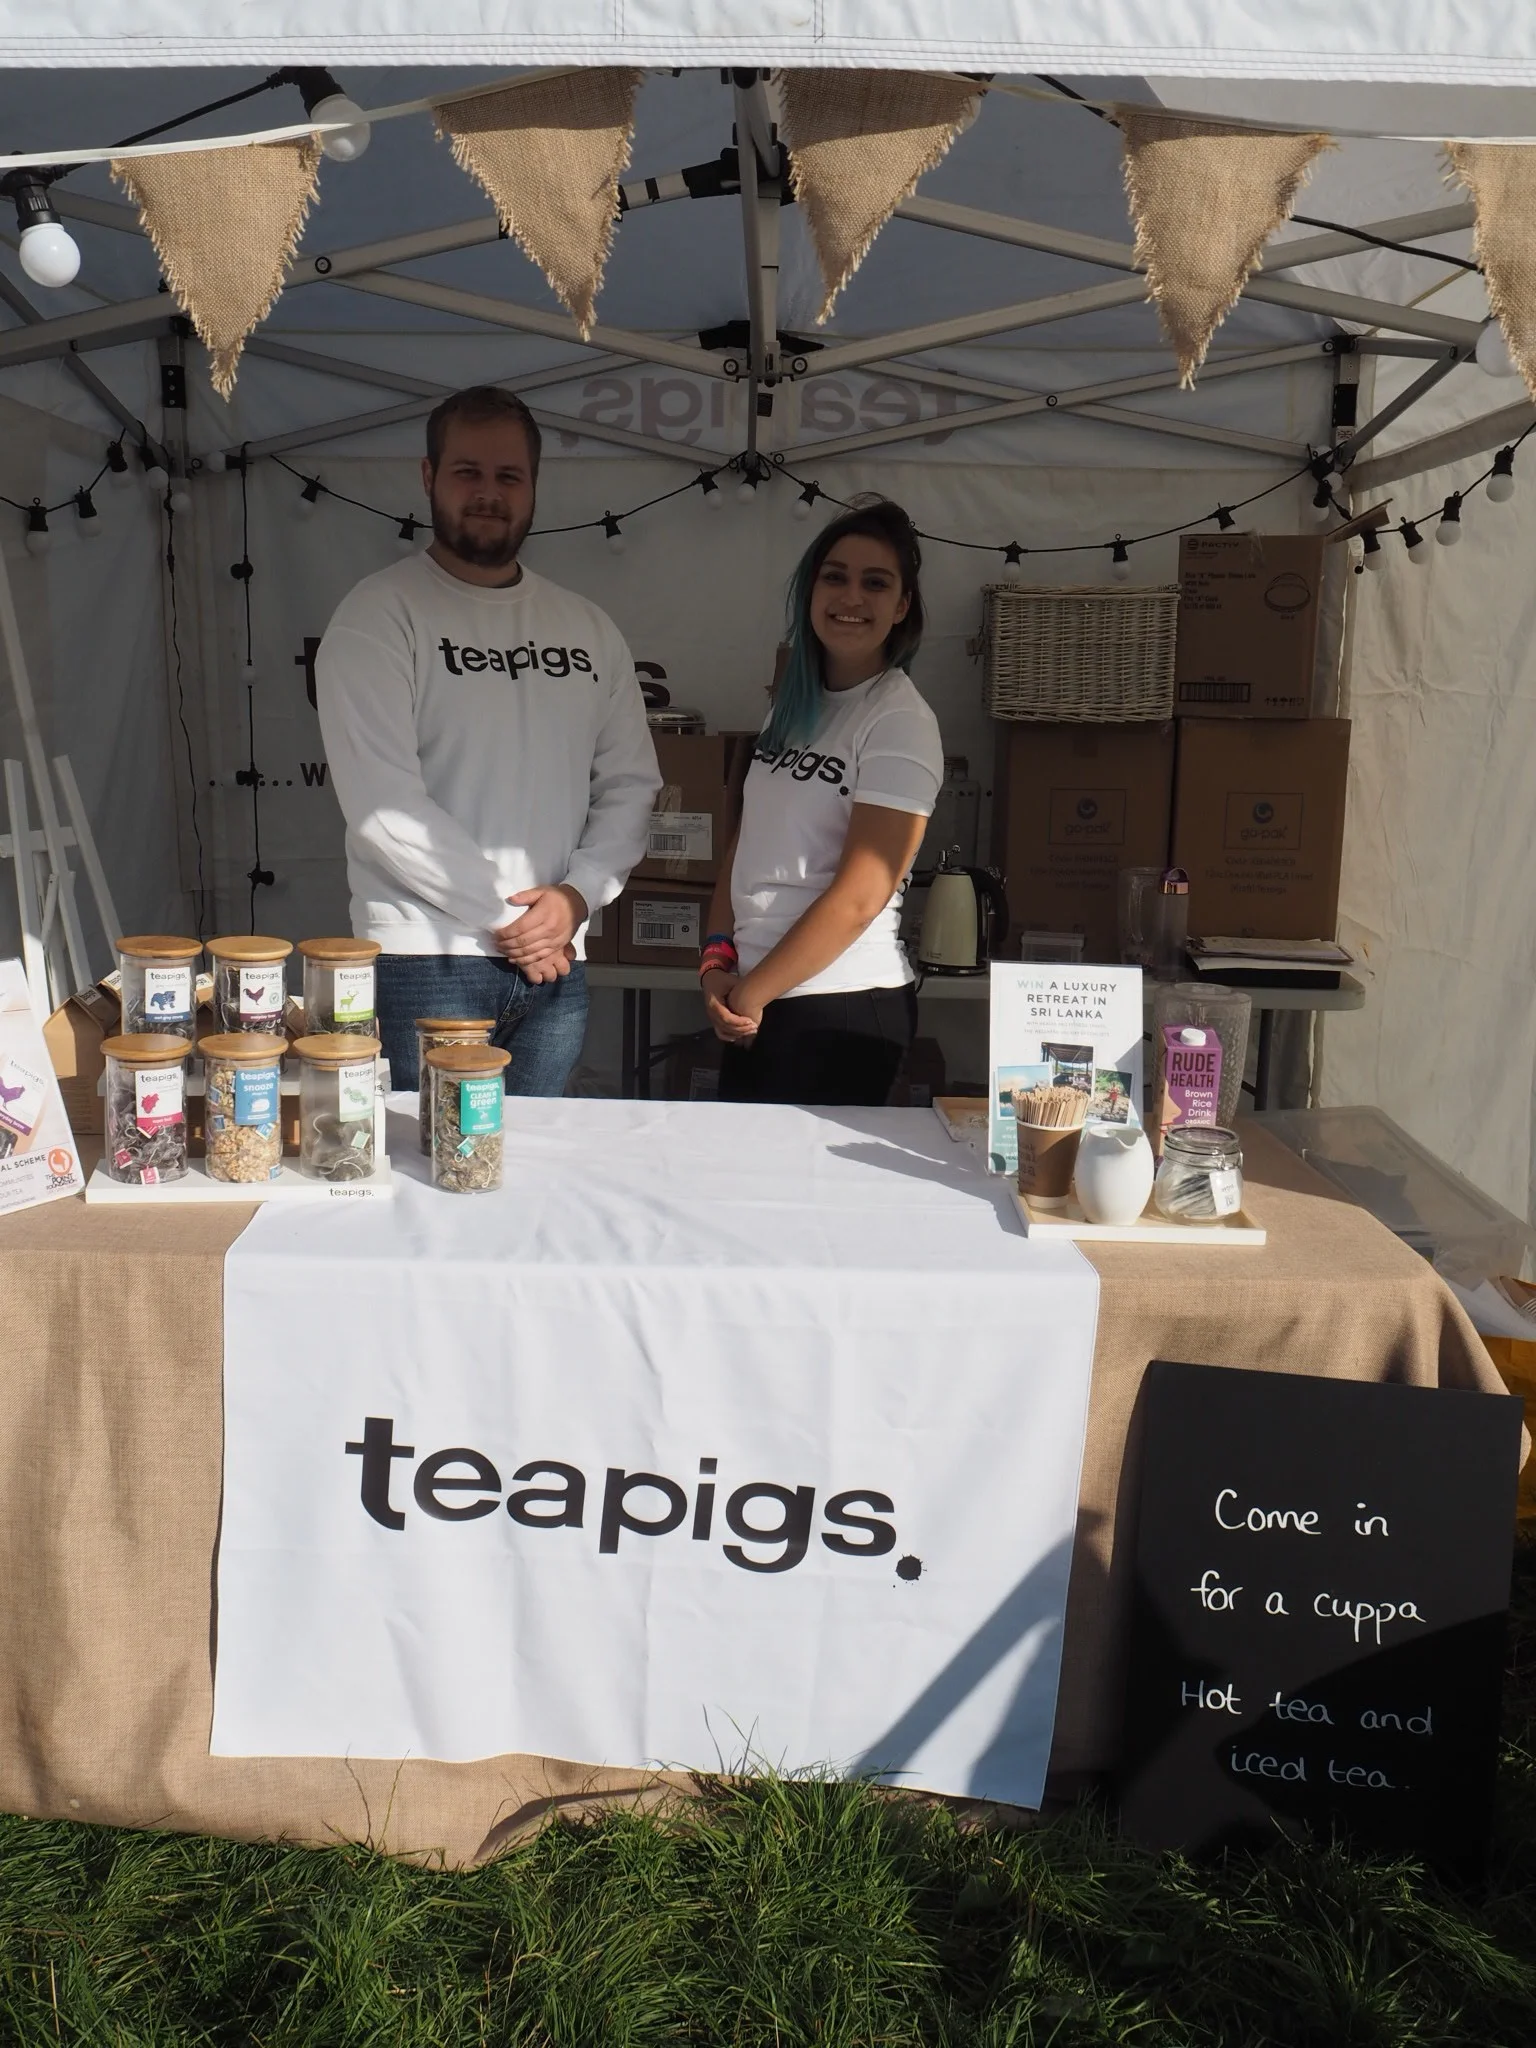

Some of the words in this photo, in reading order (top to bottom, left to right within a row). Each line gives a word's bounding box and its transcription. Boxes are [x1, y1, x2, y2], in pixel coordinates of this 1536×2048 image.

[438, 637, 599, 683] teapigs.
[752, 744, 849, 796] apigs.
[150, 971, 187, 981] teapigs.
[245, 971, 280, 981] teapigs.
[339, 971, 372, 981] teapigs.
[1017, 980, 1044, 990] WIN
[1049, 981, 1059, 990] A
[1063, 982, 1117, 992] LUXURY
[1027, 993, 1088, 1005] RETREAT
[1093, 996, 1107, 1006] IN
[1030, 1007, 1052, 1017] SRI
[1057, 1008, 1103, 1020] LANKA
[1171, 1052, 1216, 1073] RUDE
[140, 1072, 179, 1083] teapigs.
[240, 1071, 276, 1081] teapigs.
[1170, 1073, 1214, 1088] HEALTH
[243, 1083, 274, 1092] snooze
[1184, 1089, 1213, 1099] Brown
[1192, 1099, 1212, 1108] Rice
[1188, 1108, 1212, 1117] Drink
[14, 1154, 47, 1169] SCHEME
[329, 1187, 374, 1197] teapigs.
[345, 1416, 926, 1585] teapigs.
[1215, 1488, 1321, 1535] Come
[1354, 1502, 1389, 1536] in
[1191, 1569, 1243, 1611] for
[1265, 1590, 1289, 1616] a
[1313, 1592, 1426, 1645] cuppa
[1181, 1680, 1242, 1715] Hot
[1269, 1691, 1335, 1726] tea
[1360, 1706, 1433, 1736] and
[1231, 1745, 1306, 1782] iced
